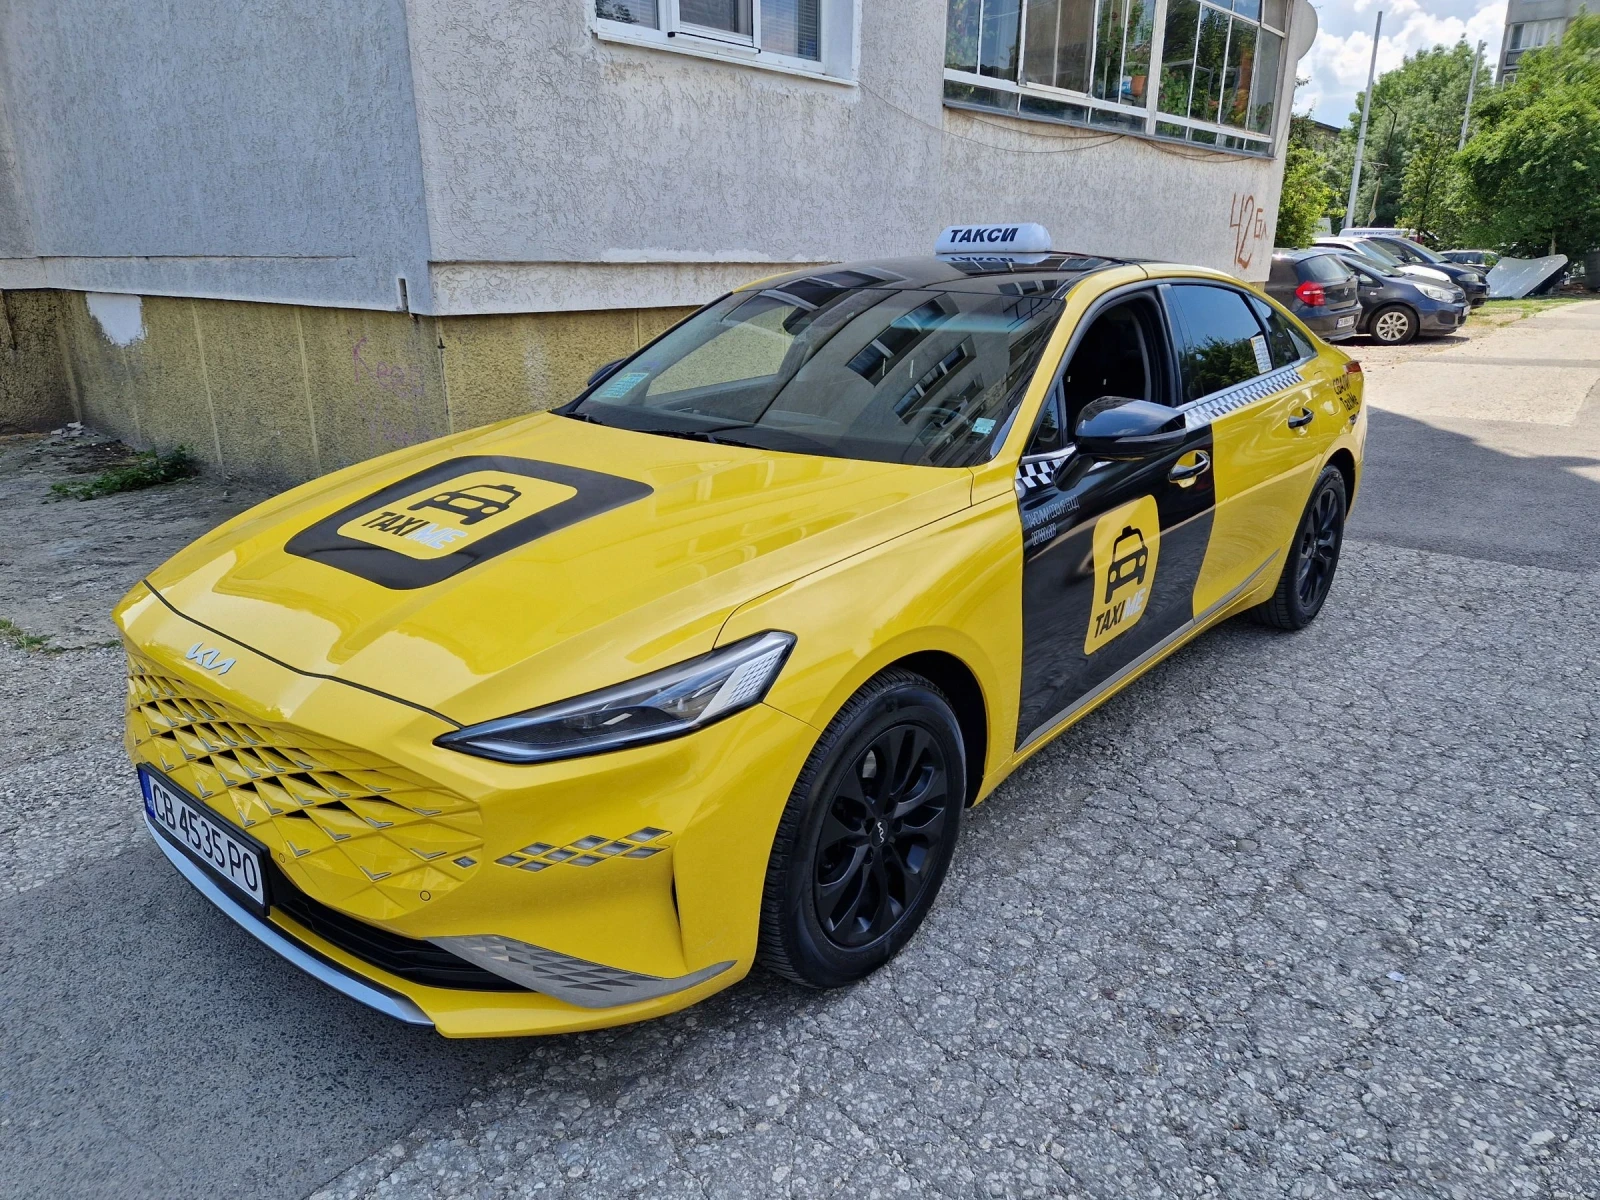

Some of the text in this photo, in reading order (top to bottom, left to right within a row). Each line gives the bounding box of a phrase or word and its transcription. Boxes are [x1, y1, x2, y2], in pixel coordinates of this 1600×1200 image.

[950, 228, 1018, 242] ТАКСИ
[1230, 192, 1255, 270] 42
[179, 805, 226, 869] 4535
